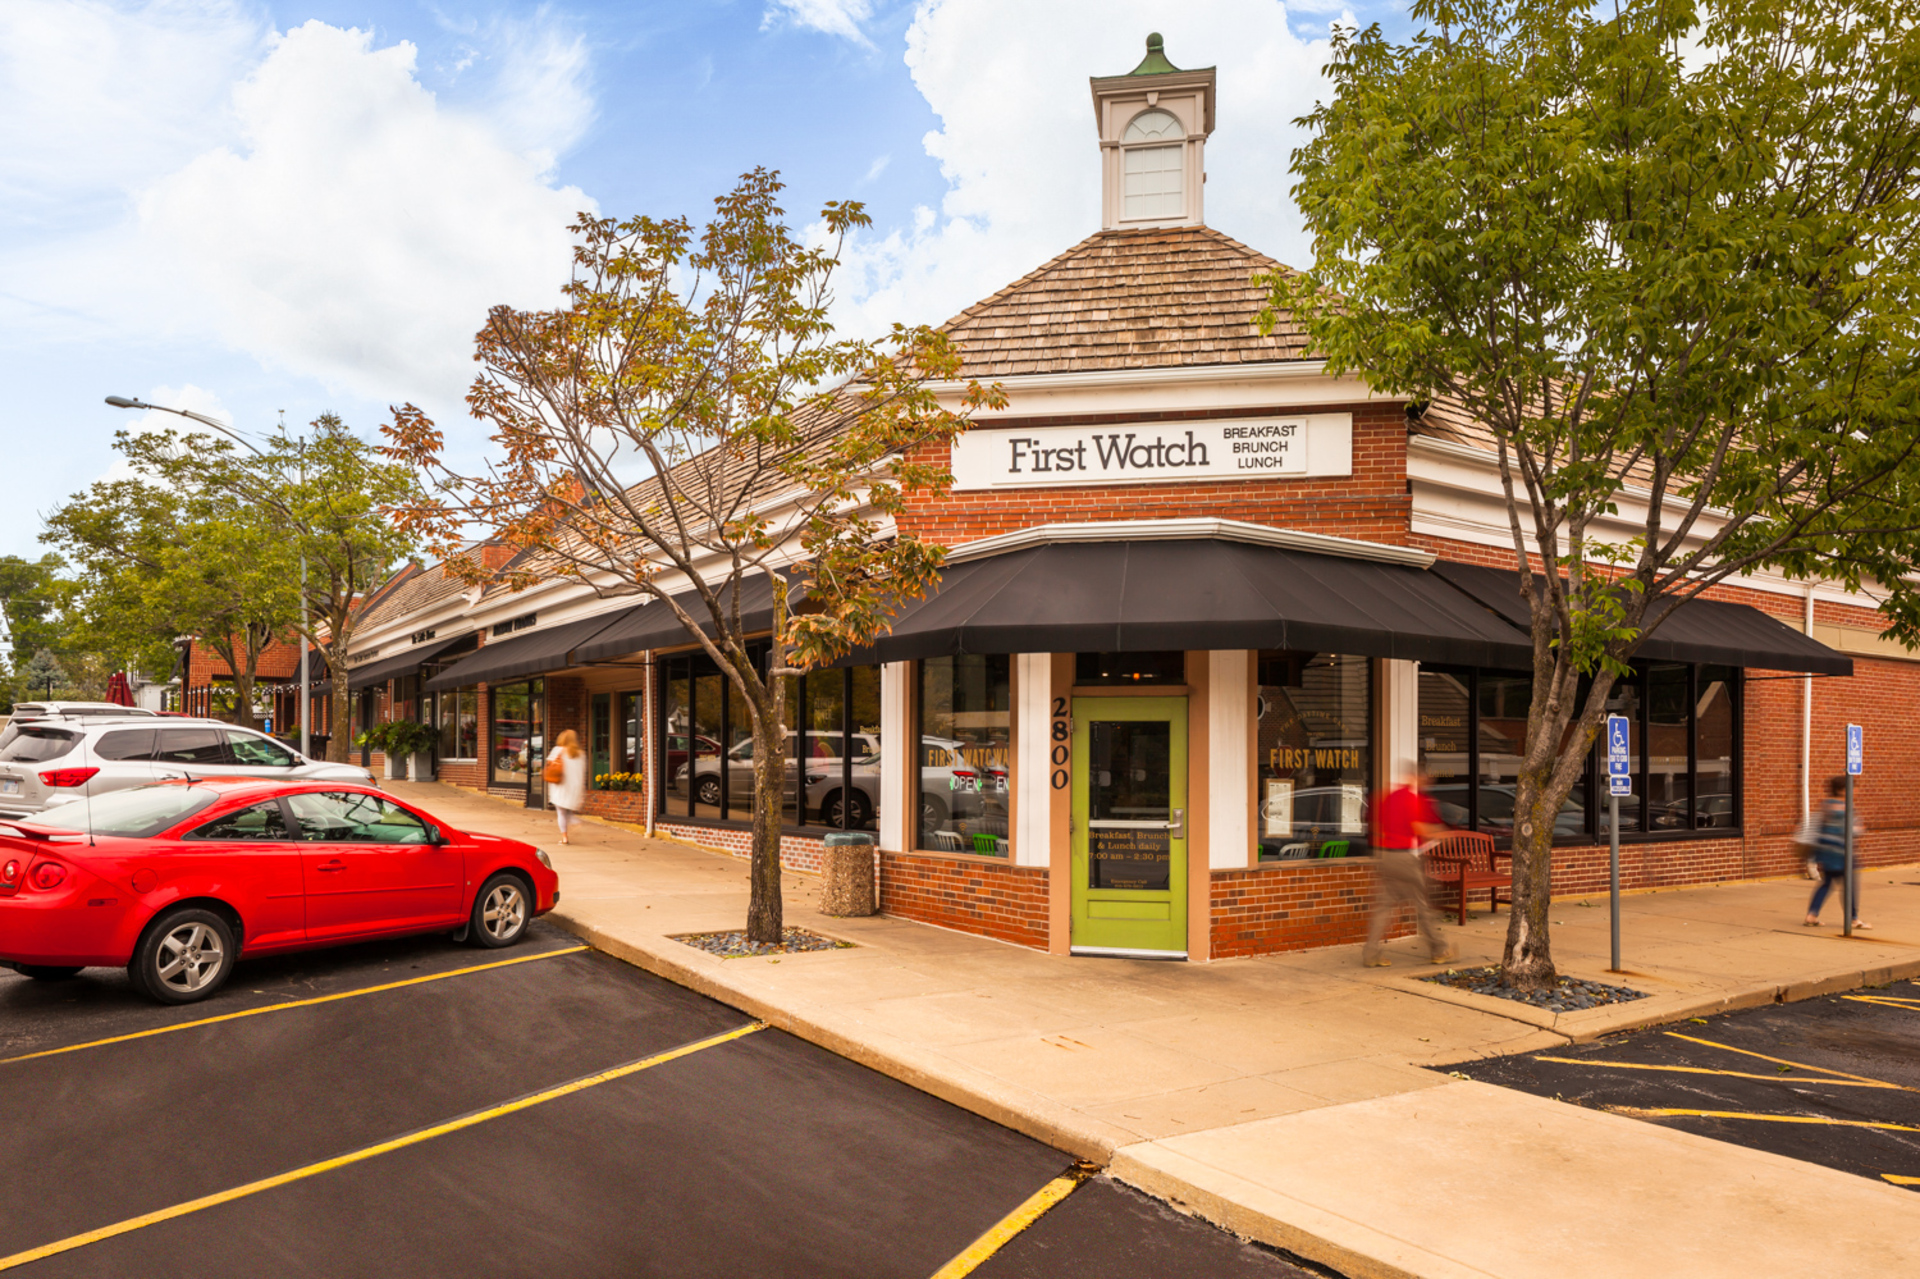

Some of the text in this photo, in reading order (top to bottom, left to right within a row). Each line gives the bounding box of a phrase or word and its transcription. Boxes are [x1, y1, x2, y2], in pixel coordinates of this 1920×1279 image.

[1223, 425, 1298, 439] BREAKFAST
[1008, 431, 1210, 473] First Watch
[1232, 441, 1289, 454] BRUNCH
[1238, 456, 1283, 469] LUNCH
[1421, 715, 1461, 727] Breakfast
[1051, 696, 1069, 790] 2800
[1426, 740, 1457, 751] Brunch
[928, 749, 959, 767] FIRST
[1270, 748, 1359, 769] FIRST WATCH
[953, 776, 979, 791] OPEN
[1089, 831, 1170, 840] Breakfast, Brunch
[1108, 842, 1136, 850] Lunch
[1139, 842, 1161, 851] daily
[1089, 852, 1108, 860] 7:00
